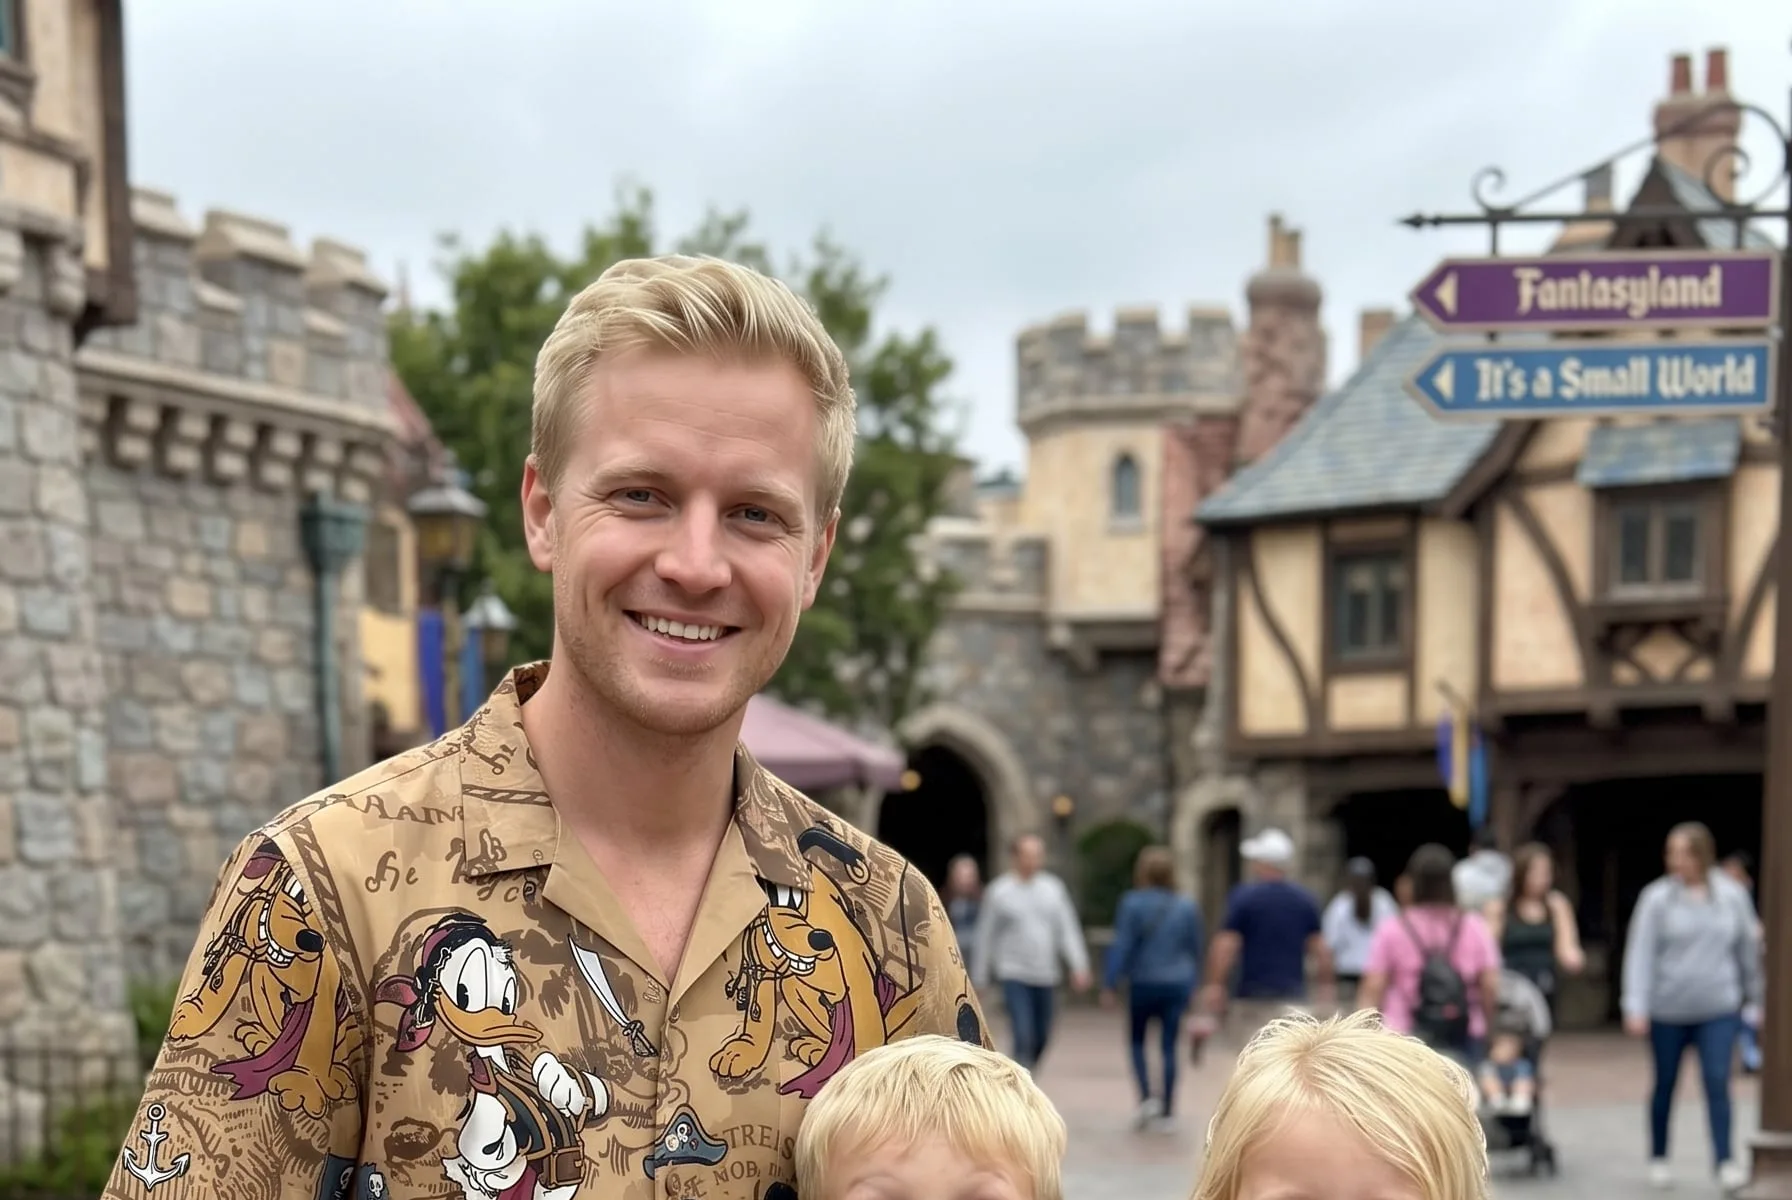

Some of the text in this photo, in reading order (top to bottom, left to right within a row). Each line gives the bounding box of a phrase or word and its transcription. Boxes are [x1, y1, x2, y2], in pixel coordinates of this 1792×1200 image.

[1513, 264, 1722, 319] Fantasyland
[1475, 353, 1756, 401] It's a Small World
